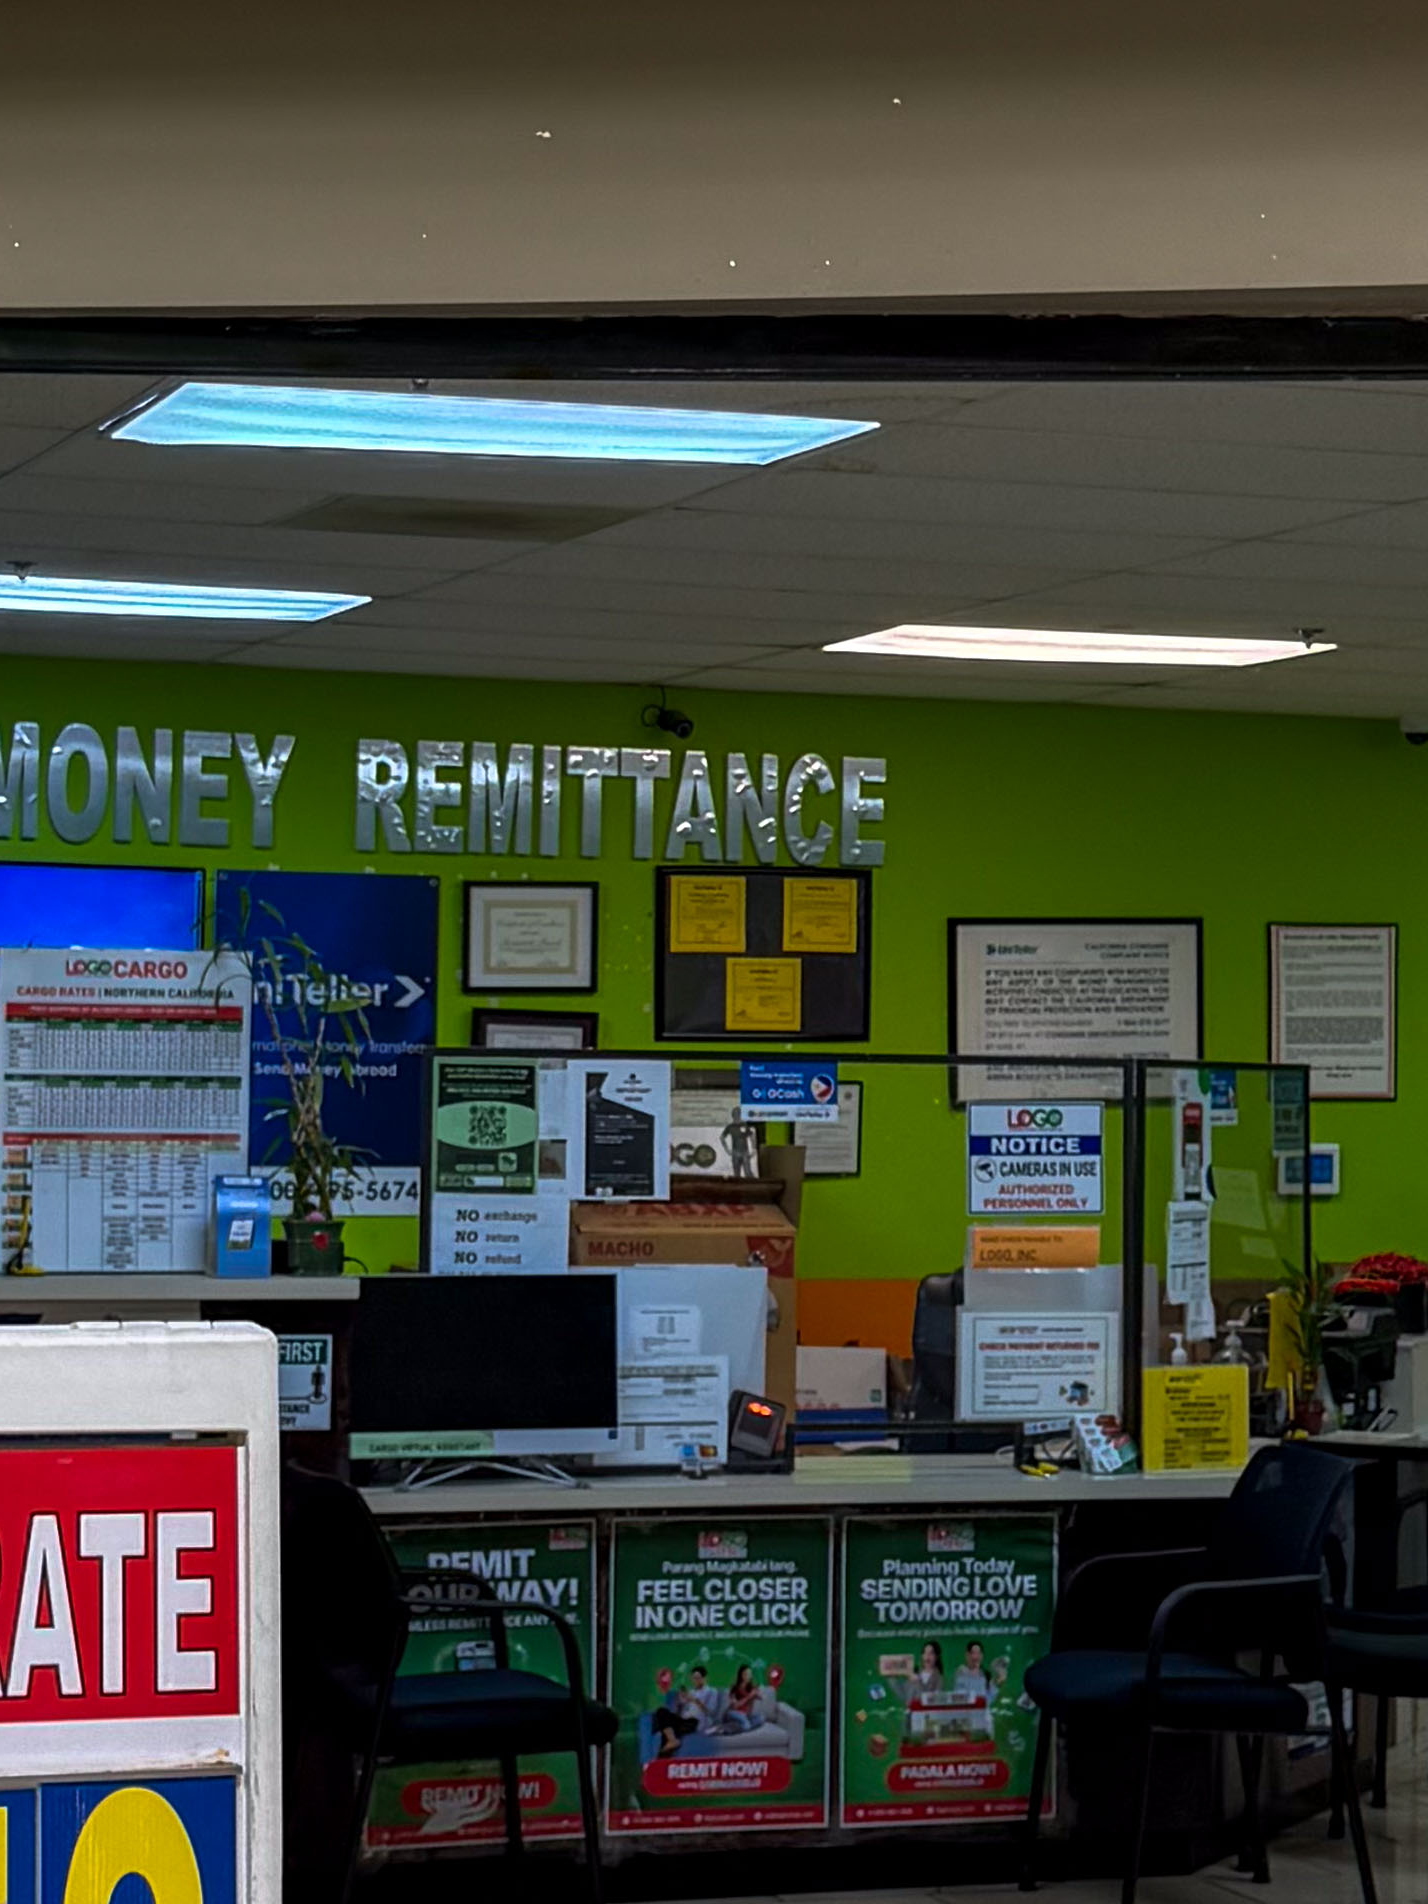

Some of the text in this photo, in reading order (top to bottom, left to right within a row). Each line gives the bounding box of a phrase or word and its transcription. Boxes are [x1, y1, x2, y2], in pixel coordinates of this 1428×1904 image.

[355, 738, 887, 867] REMITTANCE
[1007, 1109, 1063, 1128] LOGO
[990, 1138, 1081, 1154] NOTICE
[999, 1161, 1097, 1177] CAMERAS IN USE
[998, 1184, 1074, 1196] AUTHORIZED
[983, 1198, 1088, 1209] PERSONNEL ONLY
[455, 1209, 480, 1222] NO
[454, 1231, 478, 1243] NO
[587, 1241, 654, 1257] MACHO
[454, 1252, 477, 1264] NO
[961, 1557, 1015, 1575] Today
[637, 1577, 809, 1603] FEEL CLOSER
[860, 1575, 1038, 1600] SENDING LOVE
[635, 1602, 809, 1628] IN ONE CLICK
[873, 1598, 1025, 1623] TOMORROW
